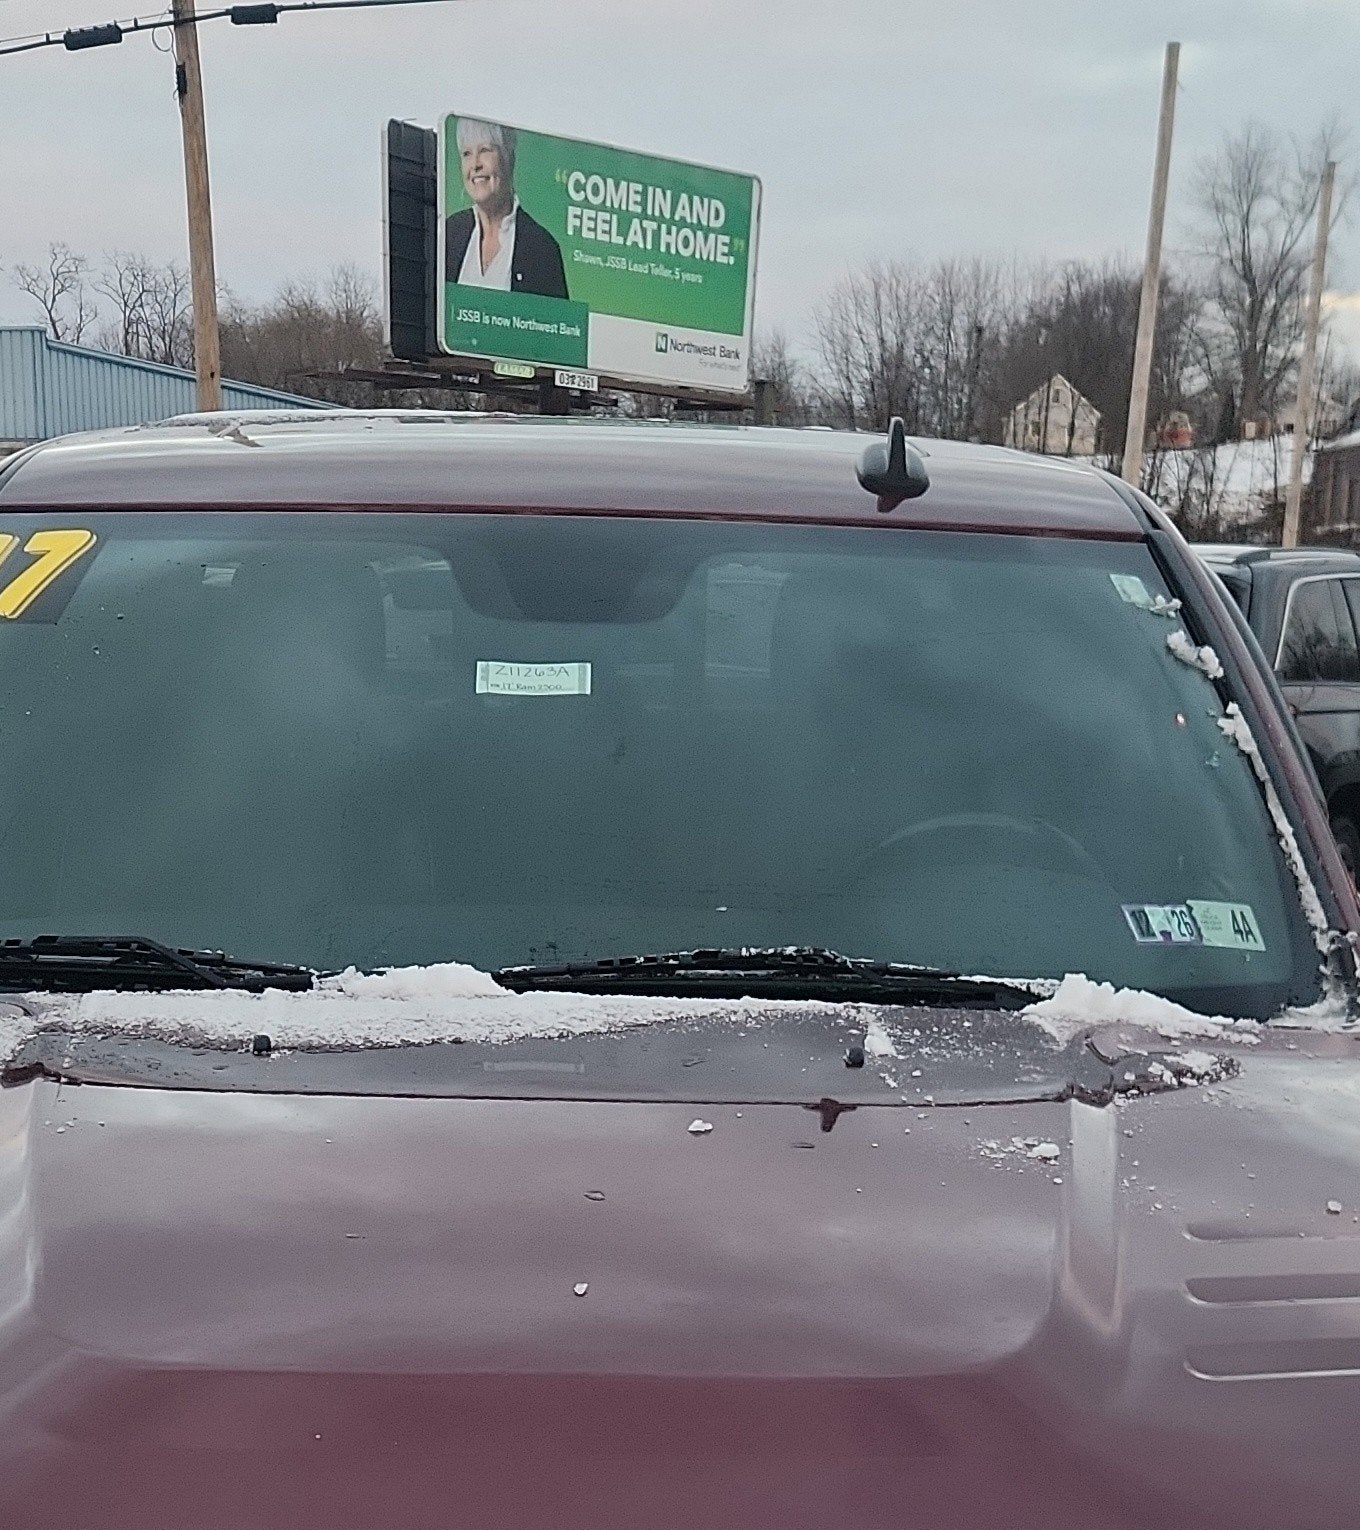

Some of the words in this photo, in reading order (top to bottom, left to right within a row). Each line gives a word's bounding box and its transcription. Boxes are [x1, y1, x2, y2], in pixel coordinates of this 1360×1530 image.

[647, 186, 671, 219] IN
[674, 193, 726, 228] AND
[567, 206, 624, 245] FEEL
[625, 218, 658, 250] AT
[605, 255, 627, 270] JSSB
[681, 272, 703, 284] years
[456, 309, 480, 323] JSSB
[482, 312, 490, 324] is
[491, 316, 511, 327] now
[512, 316, 558, 333] Northwest
[559, 323, 581, 337] Bank
[670, 338, 716, 357] Northwest
[719, 345, 740, 360] Bank
[1170, 910, 1194, 937] 26
[1231, 909, 1258, 943] 4A
